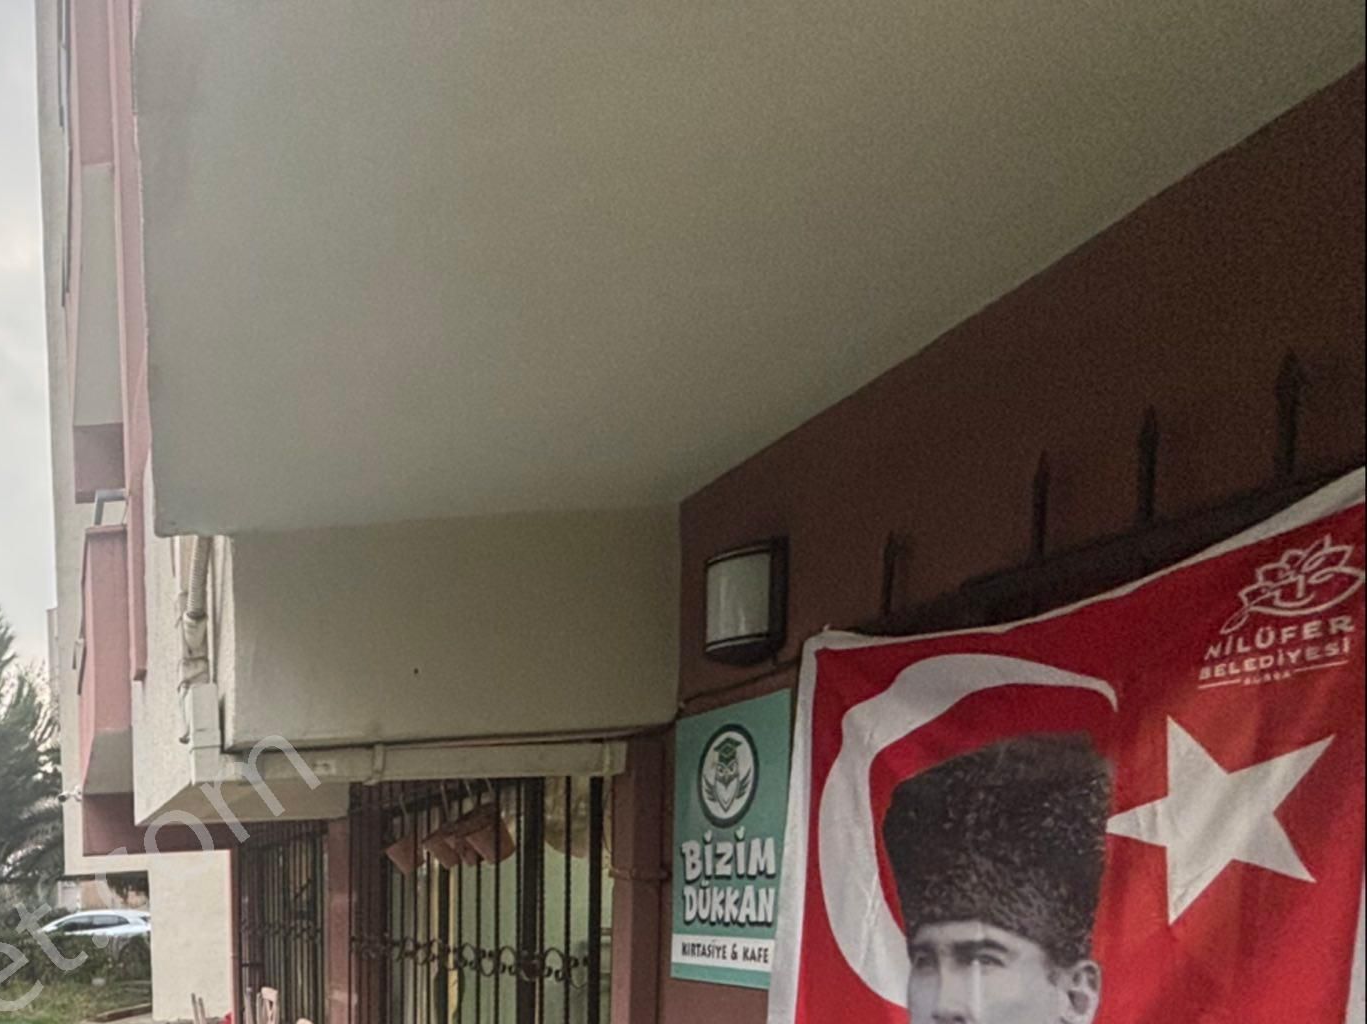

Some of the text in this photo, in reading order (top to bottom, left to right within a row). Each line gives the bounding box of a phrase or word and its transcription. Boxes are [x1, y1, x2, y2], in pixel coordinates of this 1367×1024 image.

[1198, 636, 1351, 681] BELEDİYESİ
[1204, 616, 1355, 660] NİLÜFER
[681, 826, 777, 883] BİZİM
[682, 881, 776, 926] DÜKKAN
[681, 940, 770, 964] KIRTASİYE & KAFE
